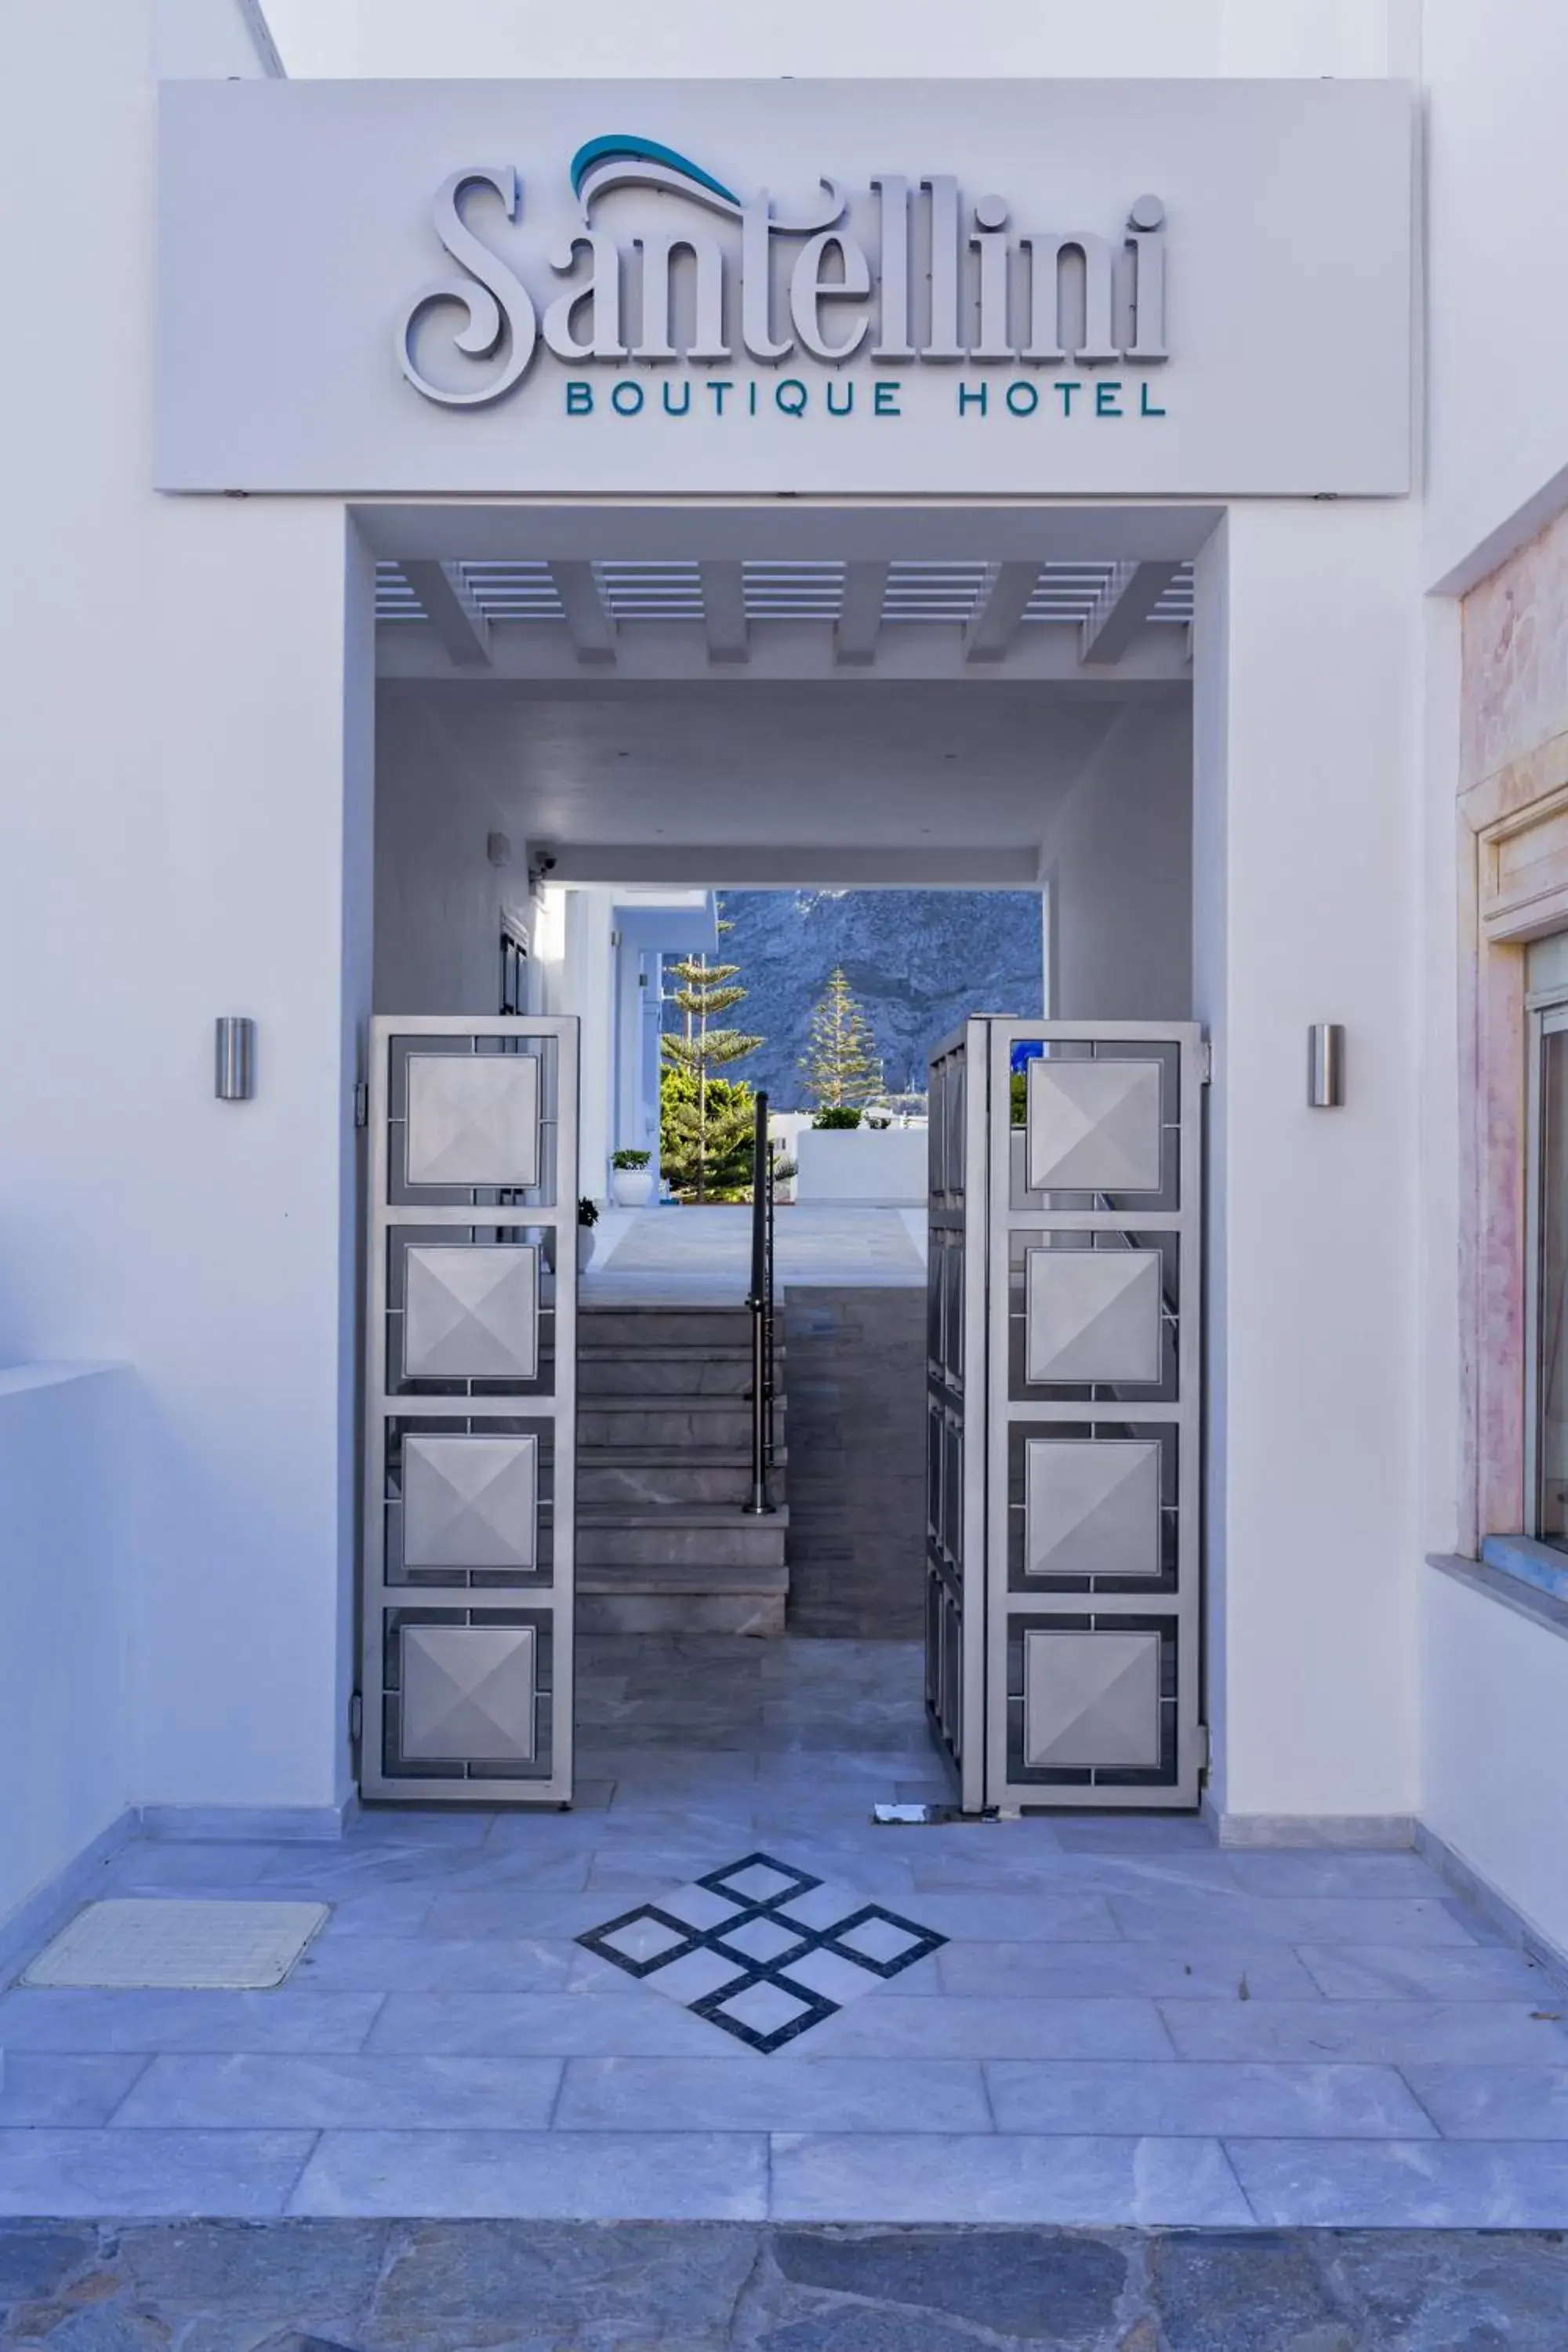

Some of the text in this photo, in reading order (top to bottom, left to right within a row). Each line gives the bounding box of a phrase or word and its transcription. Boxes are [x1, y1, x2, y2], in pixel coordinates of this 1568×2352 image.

[394, 158, 1170, 406] Santellini
[566, 381, 1167, 418] BOUTIQUE HOTEL
